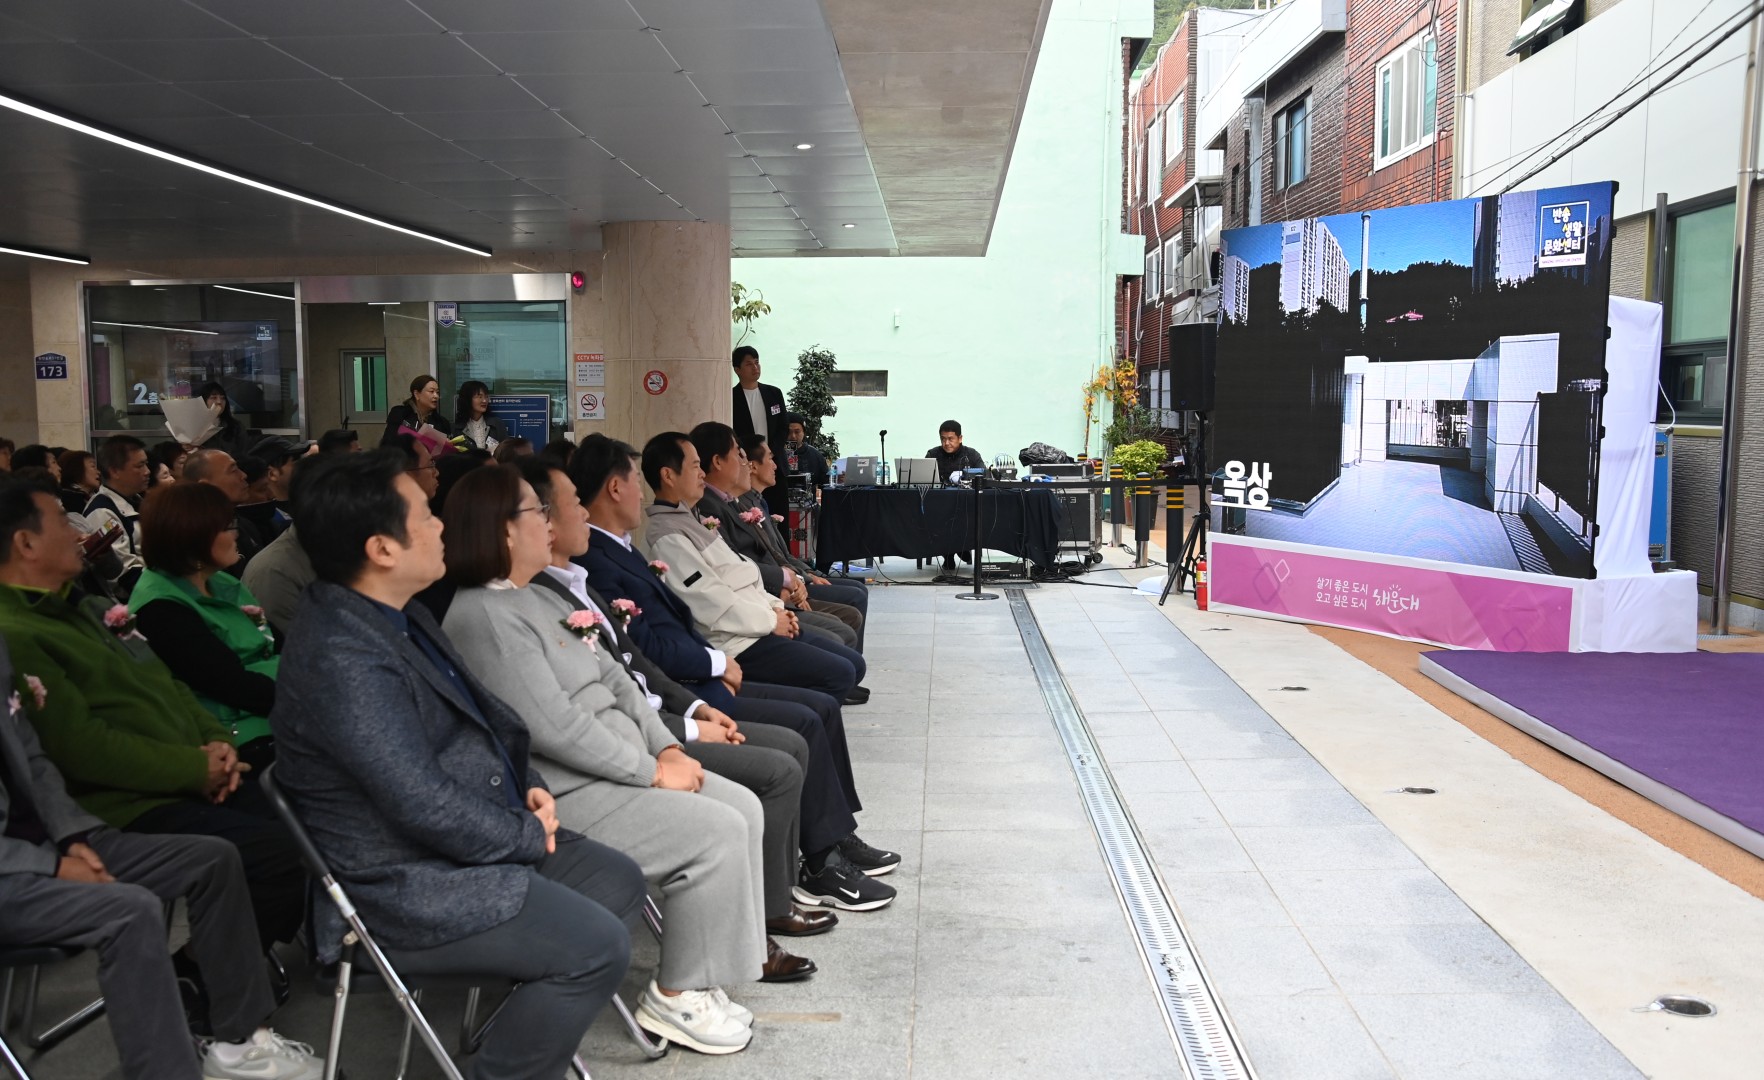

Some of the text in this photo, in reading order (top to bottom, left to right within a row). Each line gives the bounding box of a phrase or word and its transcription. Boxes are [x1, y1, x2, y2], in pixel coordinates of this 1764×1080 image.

[1552, 206, 1571, 223] 반송
[1562, 221, 1583, 238] 생활
[1544, 237, 1581, 255] 문화센터
[40, 366, 63, 377] 173
[133, 382, 160, 404] 2층
[1223, 460, 1272, 508] 옥상
[1316, 577, 1368, 595] 살기 좋은 도시
[1316, 592, 1367, 610] 오고 싶은 도시
[1372, 588, 1420, 613] 해운대
